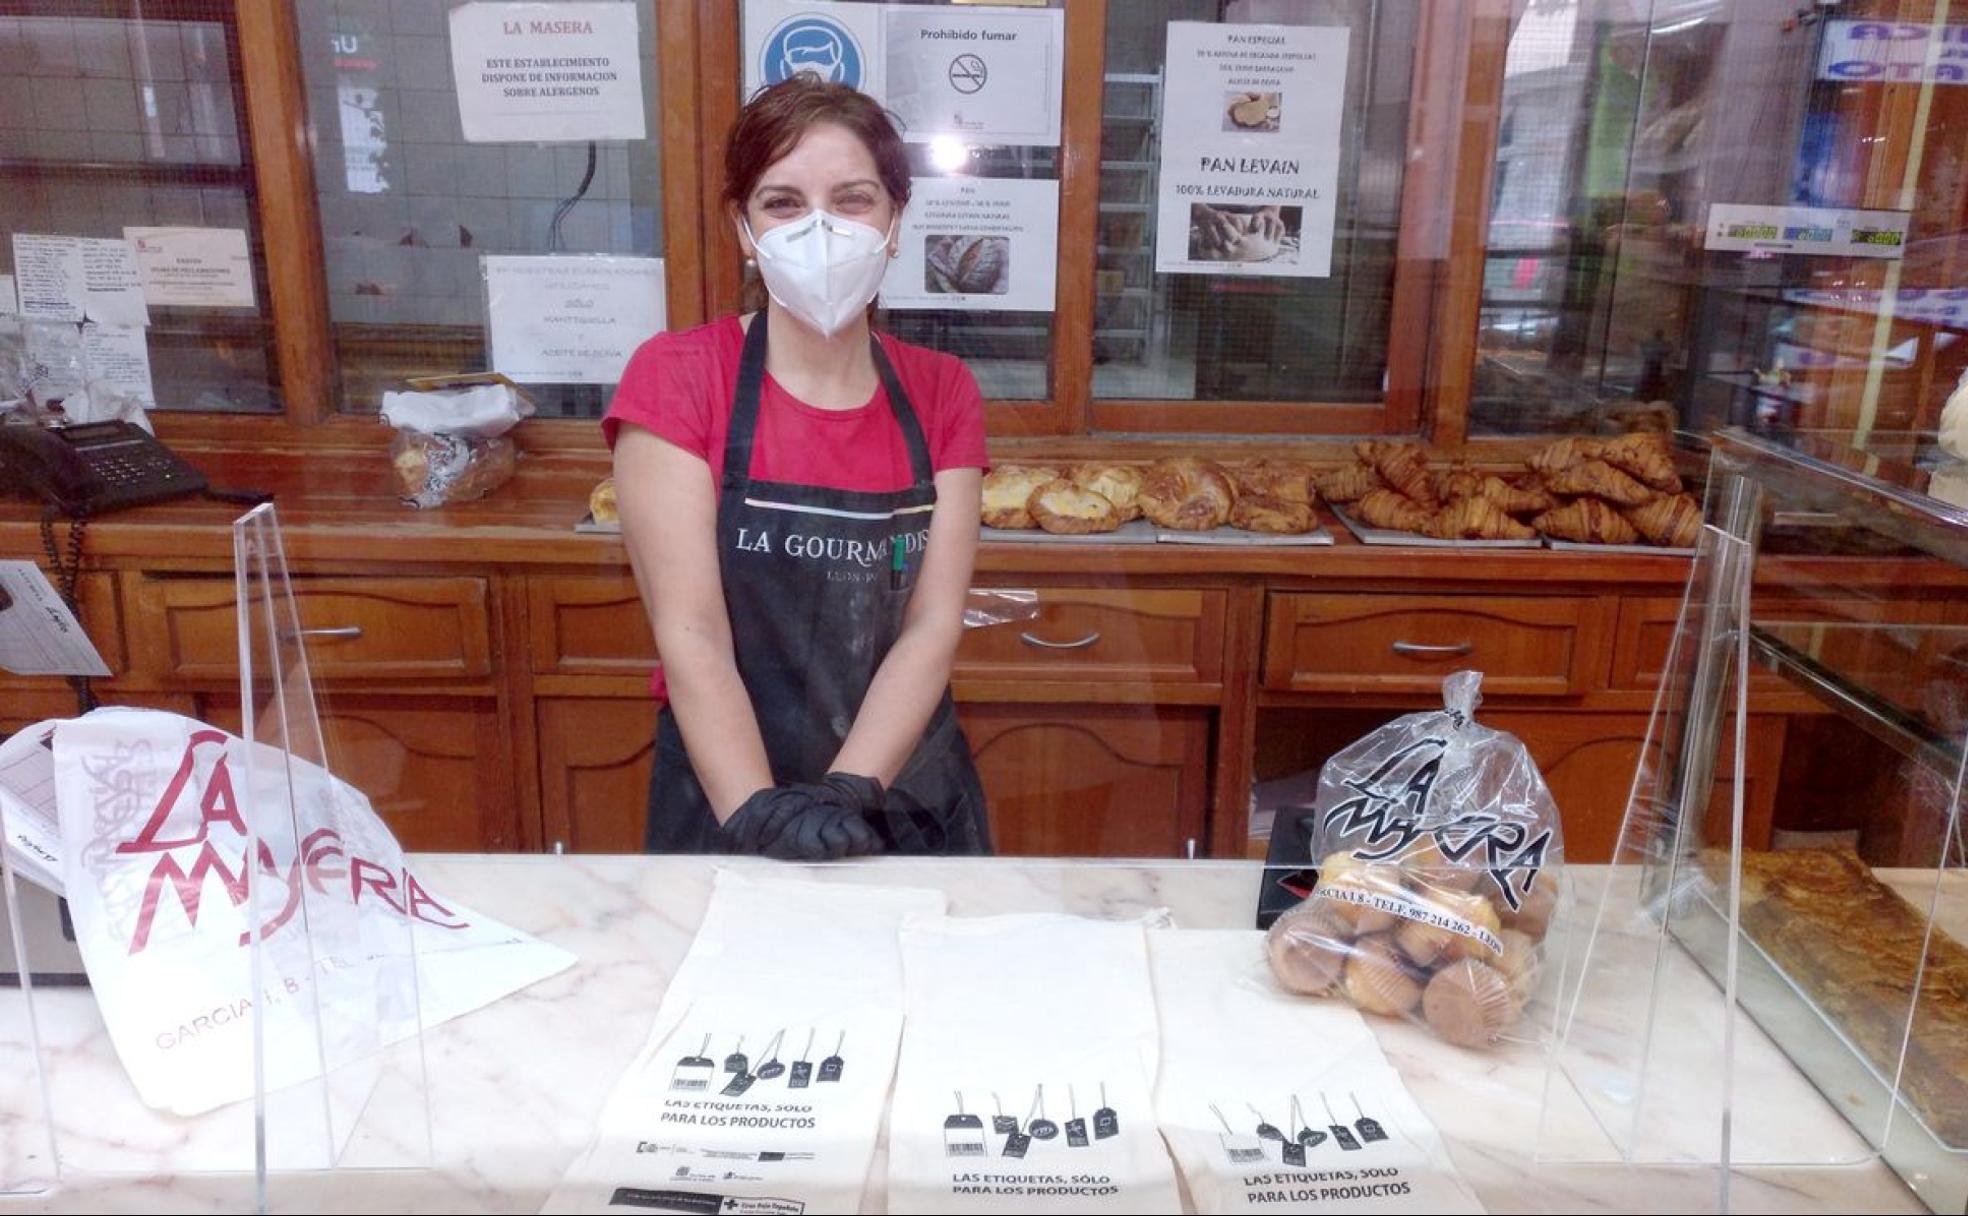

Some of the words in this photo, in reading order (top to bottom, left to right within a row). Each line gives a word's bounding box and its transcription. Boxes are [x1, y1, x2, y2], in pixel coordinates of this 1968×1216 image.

[503, 22, 522, 35] LA
[530, 21, 593, 34] MASERA
[920, 29, 978, 40] Prohibido
[981, 30, 1018, 41] fumar
[487, 58, 511, 68] ESTE
[514, 57, 610, 68] ESTABLECIMIENTO
[482, 73, 527, 83] DISPONE
[529, 73, 543, 82] DE
[545, 71, 617, 82] INFORMACION
[503, 86, 537, 97] SOBRE
[540, 86, 599, 97] ALERGENOS
[1201, 157, 1235, 173] PAN
[1240, 158, 1300, 175] LEVAIN
[1176, 184, 1204, 196] 100%
[1207, 185, 1265, 199] LEVADURA
[1266, 188, 1320, 200] NATURAL
[736, 528, 771, 553] LA
[1345, 737, 1448, 815] LA
[116, 729, 248, 855] LA
[1409, 907, 1429, 920] 987
[1431, 913, 1449, 928] 214
[1452, 919, 1471, 935] 262
[155, 997, 253, 1051] GARCIA
[664, 1099, 690, 1109] LAS
[694, 1101, 771, 1113] ETIQUETAS,
[661, 1112, 697, 1126] PARA
[700, 1115, 727, 1127] LOS
[729, 1116, 816, 1129] PRODUCTOS
[953, 1173, 980, 1183] LAS
[984, 1174, 1068, 1185] ETIQUETAS,
[1244, 1174, 1271, 1186] LAS
[1275, 1170, 1358, 1185] ETIQUETAS,
[953, 1186, 992, 1195] PARA
[996, 1186, 1023, 1195] LOS
[1027, 1185, 1119, 1196] PRODUCTOS
[1248, 1191, 1288, 1203] PARA
[1290, 1189, 1317, 1201] LOS
[1321, 1182, 1411, 1200] PRODUCTOS
